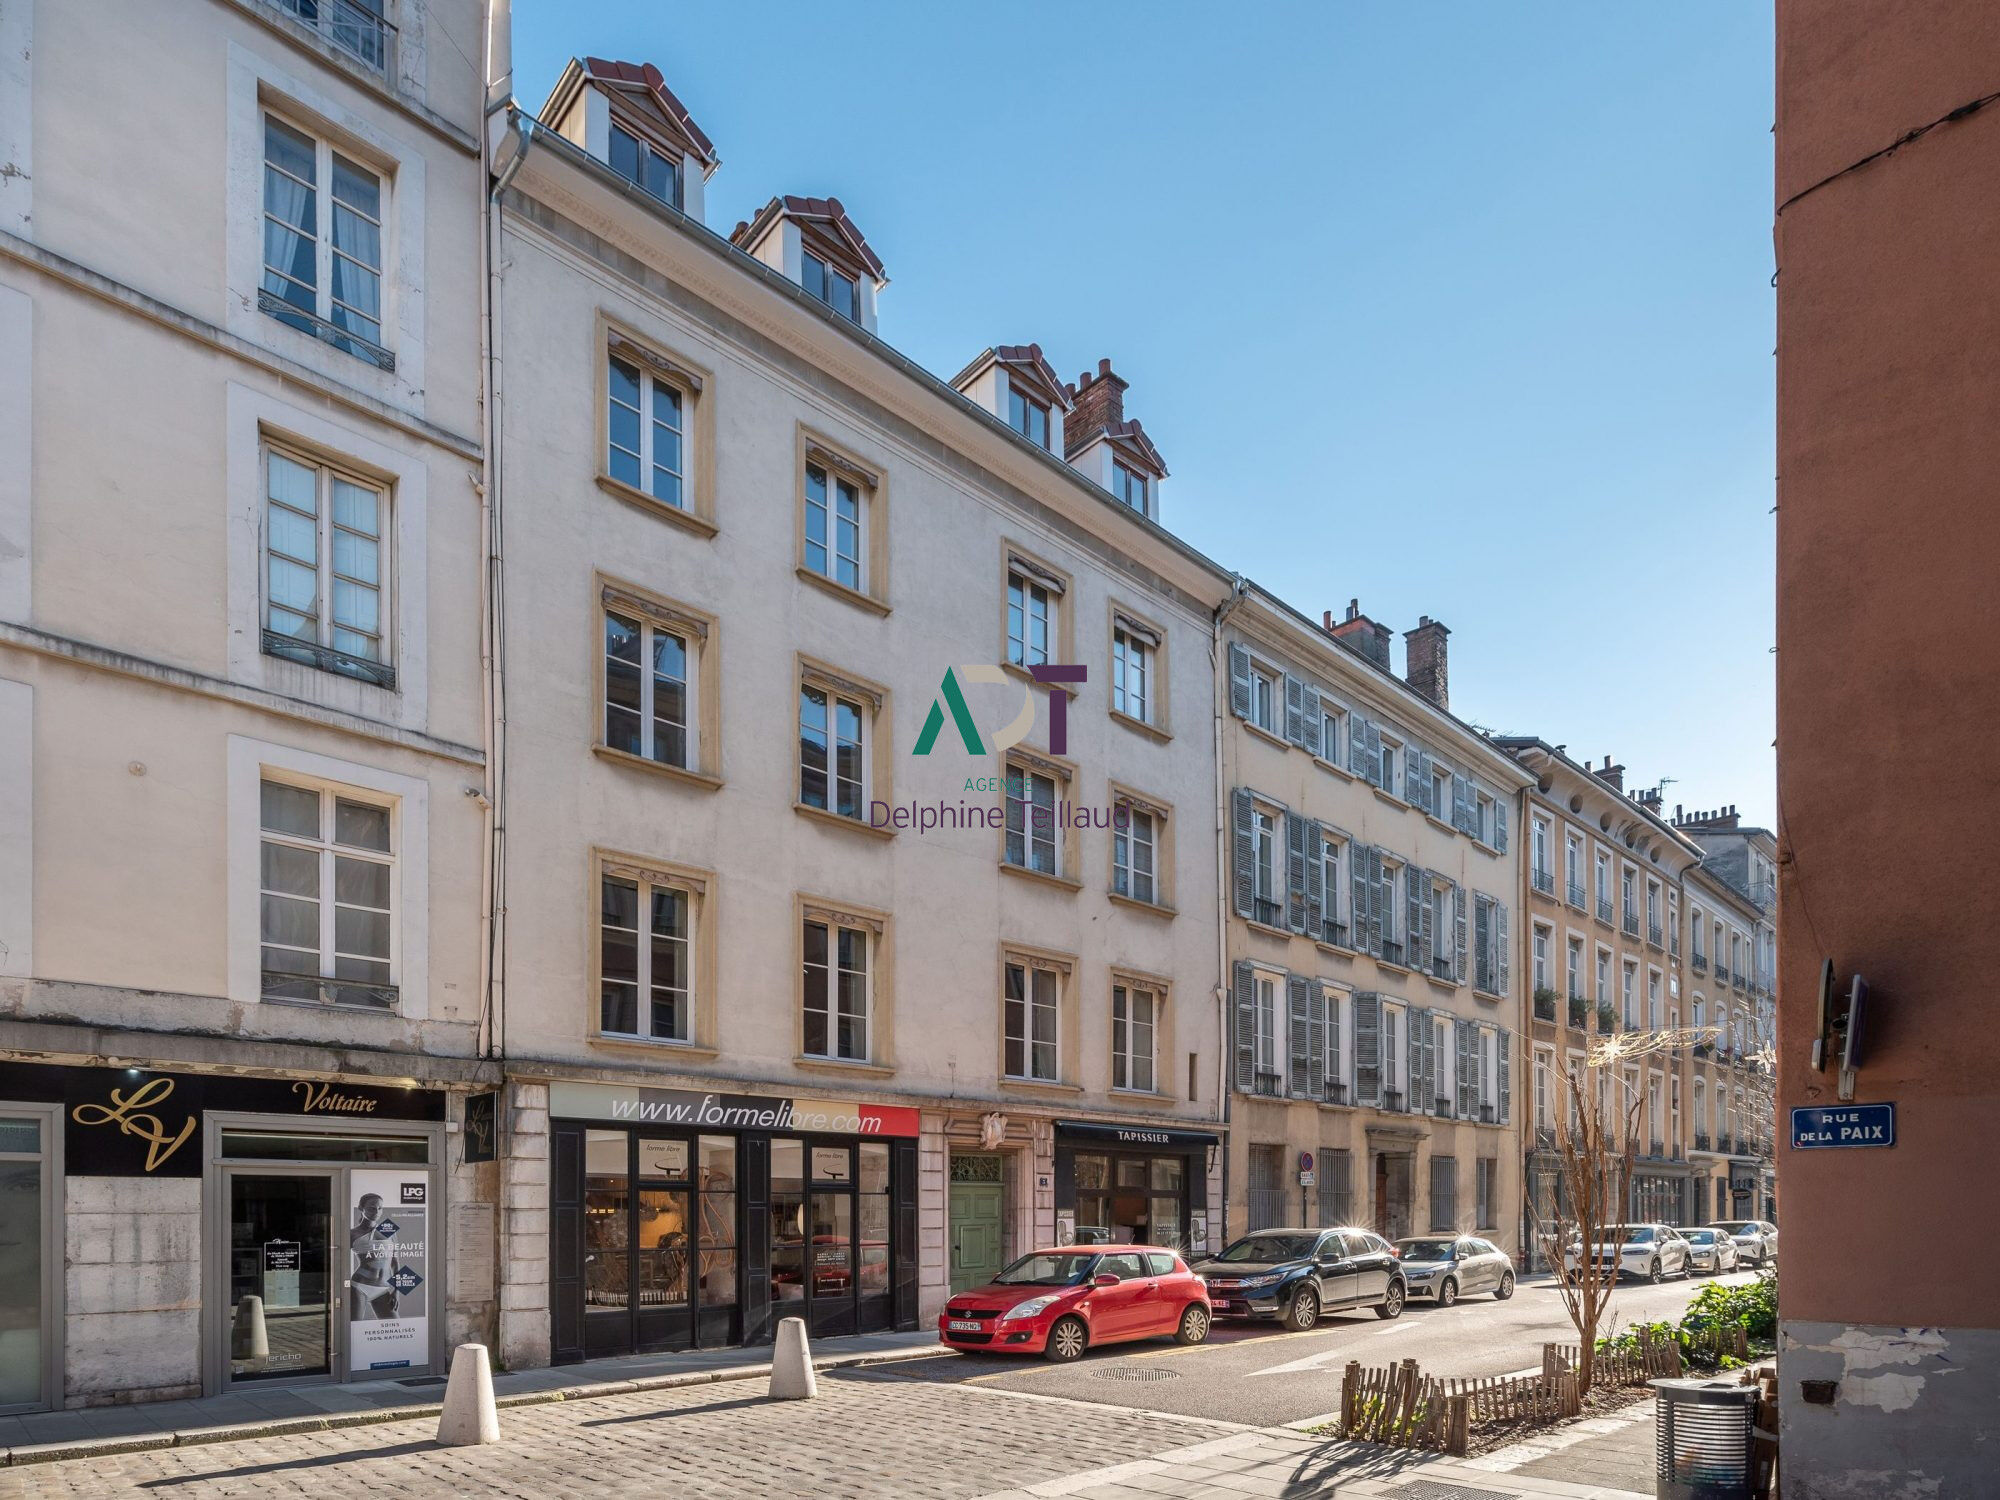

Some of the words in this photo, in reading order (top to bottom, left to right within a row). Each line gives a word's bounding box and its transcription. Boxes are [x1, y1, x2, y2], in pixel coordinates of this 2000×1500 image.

[291, 1080, 378, 1113] Voltaire
[611, 1094, 882, 1134] www.formelibre.com
[1822, 1113, 1860, 1124] RUE
[1117, 1130, 1169, 1143] TAPISSIER
[1800, 1132, 1816, 1141] DE
[1818, 1131, 1833, 1141] LA
[1840, 1125, 1883, 1140] PAIX
[403, 1187, 424, 1197] LPG
[372, 1243, 386, 1251] LA
[388, 1240, 425, 1251] BEAUTÉ
[365, 1250, 373, 1259] À
[374, 1251, 399, 1259] VOTRE
[400, 1250, 425, 1258] IMAGE
[265, 1353, 302, 1365] jericho
